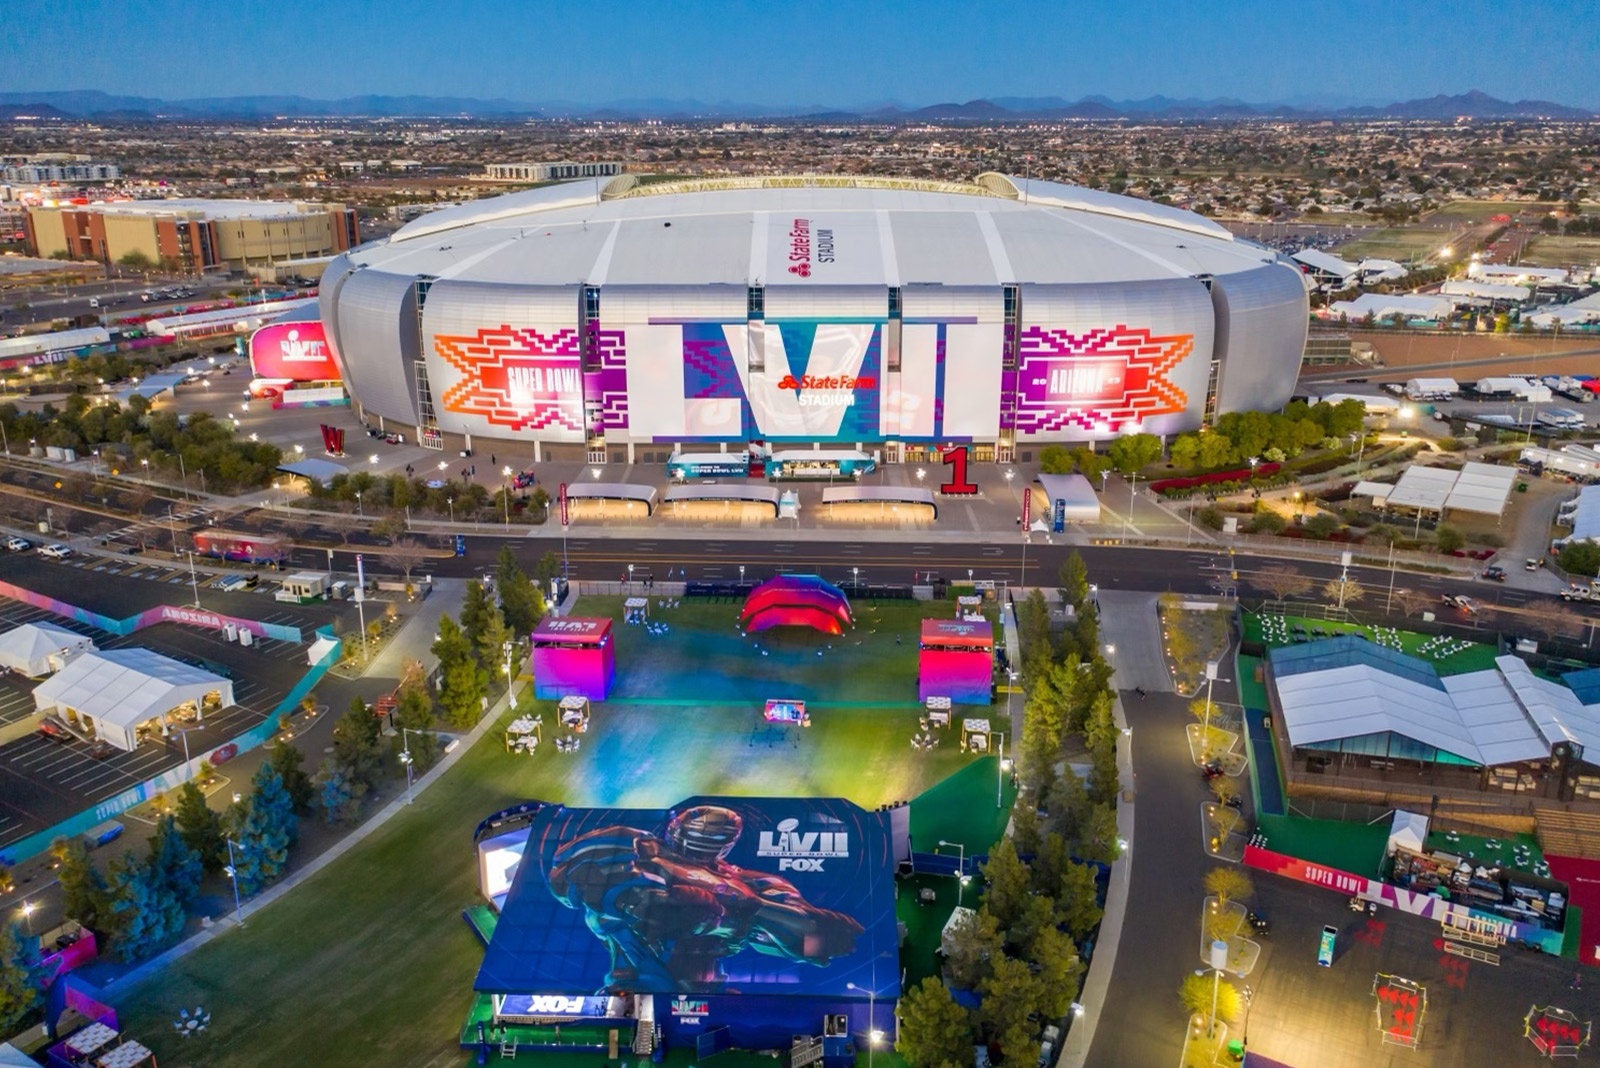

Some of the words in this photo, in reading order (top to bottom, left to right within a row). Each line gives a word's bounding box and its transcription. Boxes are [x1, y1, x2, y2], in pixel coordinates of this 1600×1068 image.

[817, 230, 834, 263] STADIUM
[507, 367, 543, 393] SUPER
[546, 367, 581, 393] BOWL
[1050, 369, 1103, 394] ARIZONA
[799, 394, 855, 406] STADIUM
[941, 446, 978, 494] 1
[758, 831, 848, 851] LVII
[779, 858, 825, 872] FOX
[1305, 866, 1333, 885] SUPER
[1336, 874, 1361, 893] BOWL
[527, 995, 585, 1013] FOX
